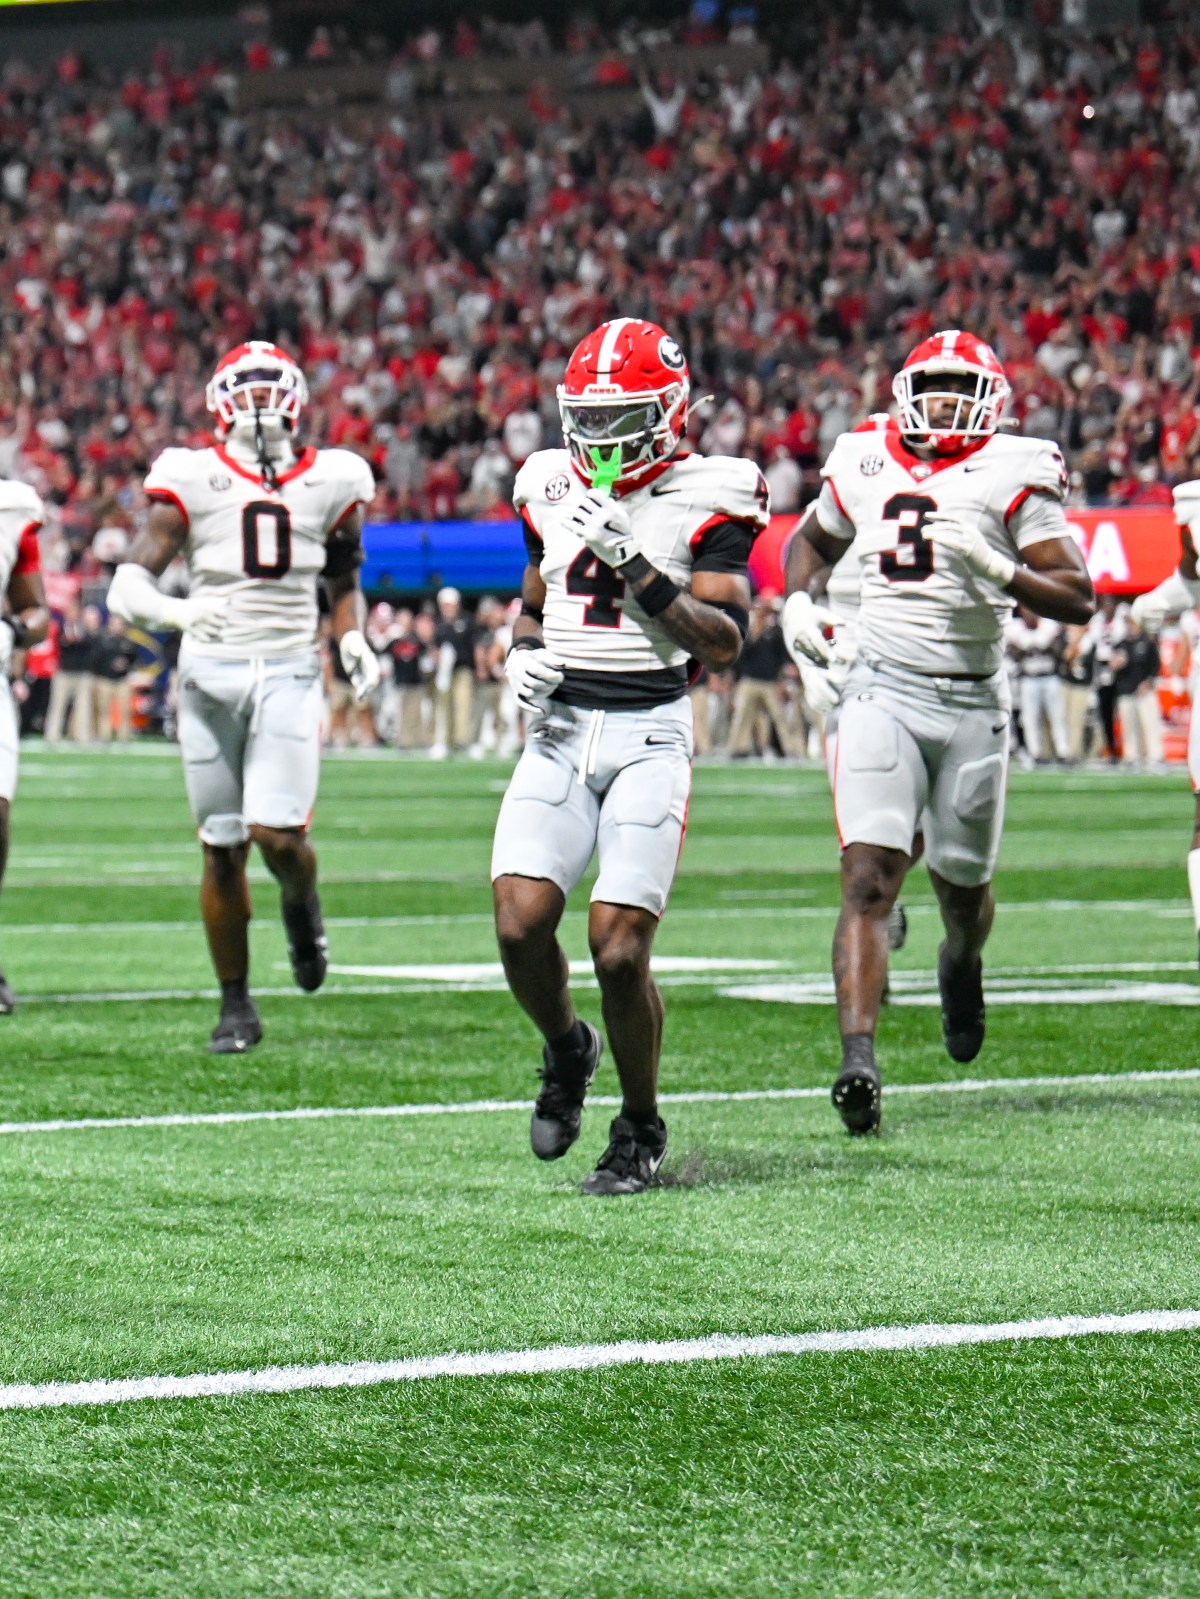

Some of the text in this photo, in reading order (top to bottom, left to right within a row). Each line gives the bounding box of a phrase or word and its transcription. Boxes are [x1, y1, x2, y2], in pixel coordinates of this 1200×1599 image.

[547, 476, 569, 501] SEC
[243, 500, 291, 579] 0
[879, 493, 938, 582] 3
[566, 545, 625, 629] 4
